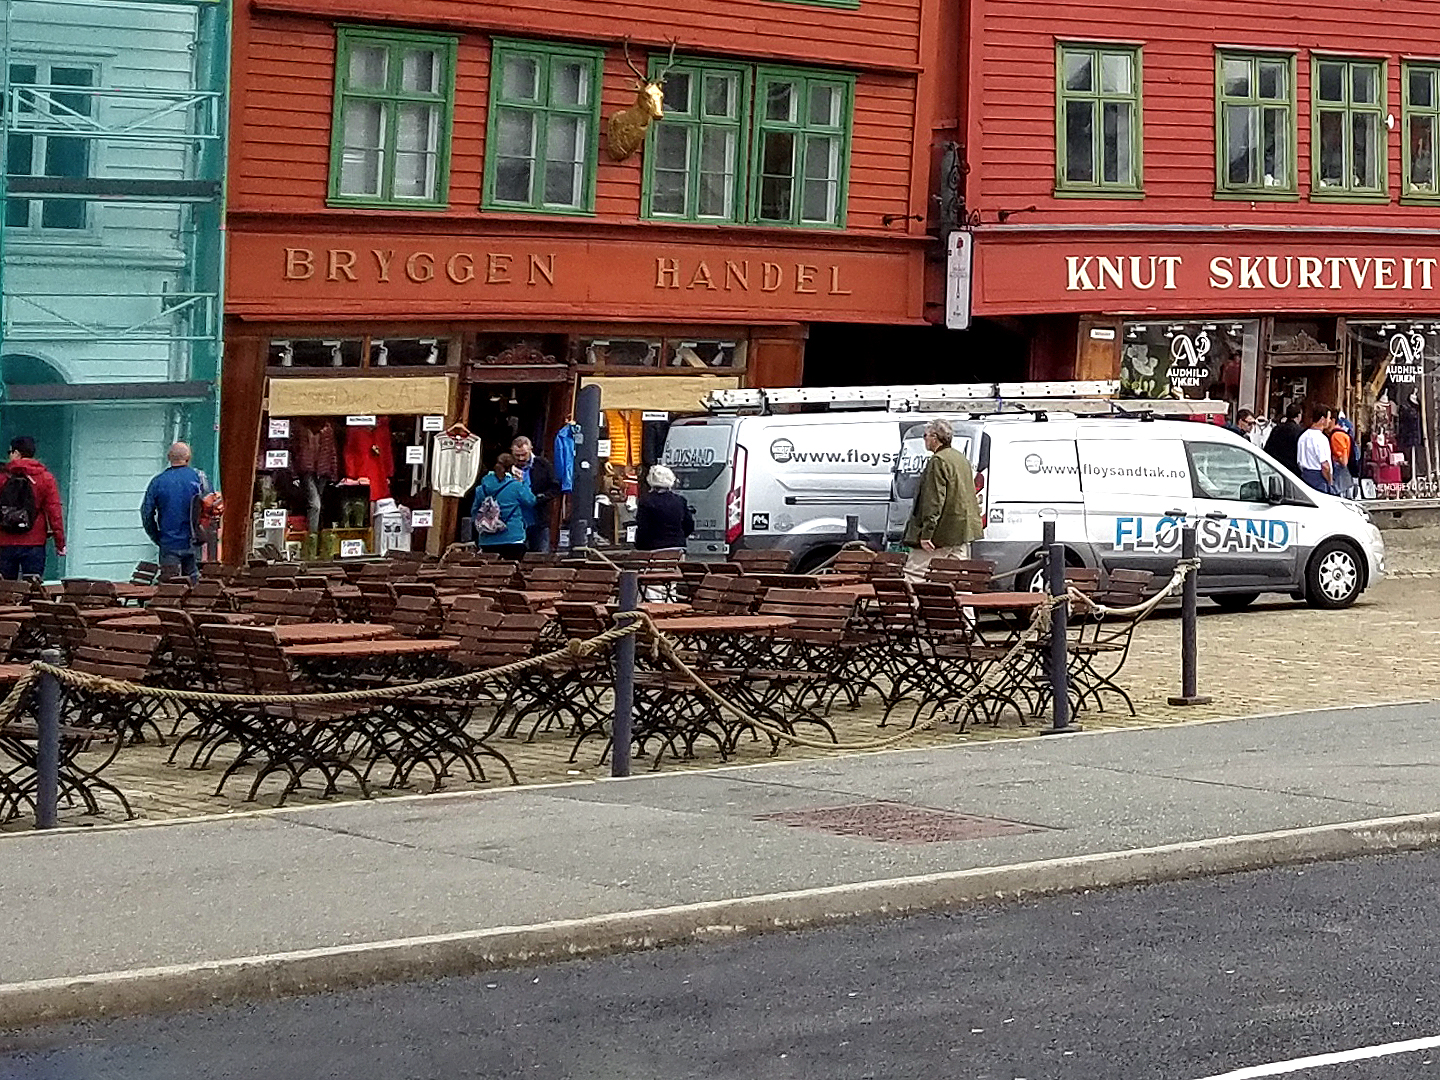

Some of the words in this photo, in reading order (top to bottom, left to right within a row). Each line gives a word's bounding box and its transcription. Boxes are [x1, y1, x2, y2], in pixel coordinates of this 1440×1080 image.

[283, 247, 556, 285] BRYGGEN
[655, 257, 852, 296] HANDEL
[1065, 256, 1182, 291] KNUT
[1208, 256, 1438, 290] SKURTVEIT
[1166, 368, 1209, 378] AUDHILD
[1386, 365, 1423, 375] AUDHILD
[1171, 377, 1199, 387] VIKEN
[1041, 463, 1187, 478] www.floysandtak.no
